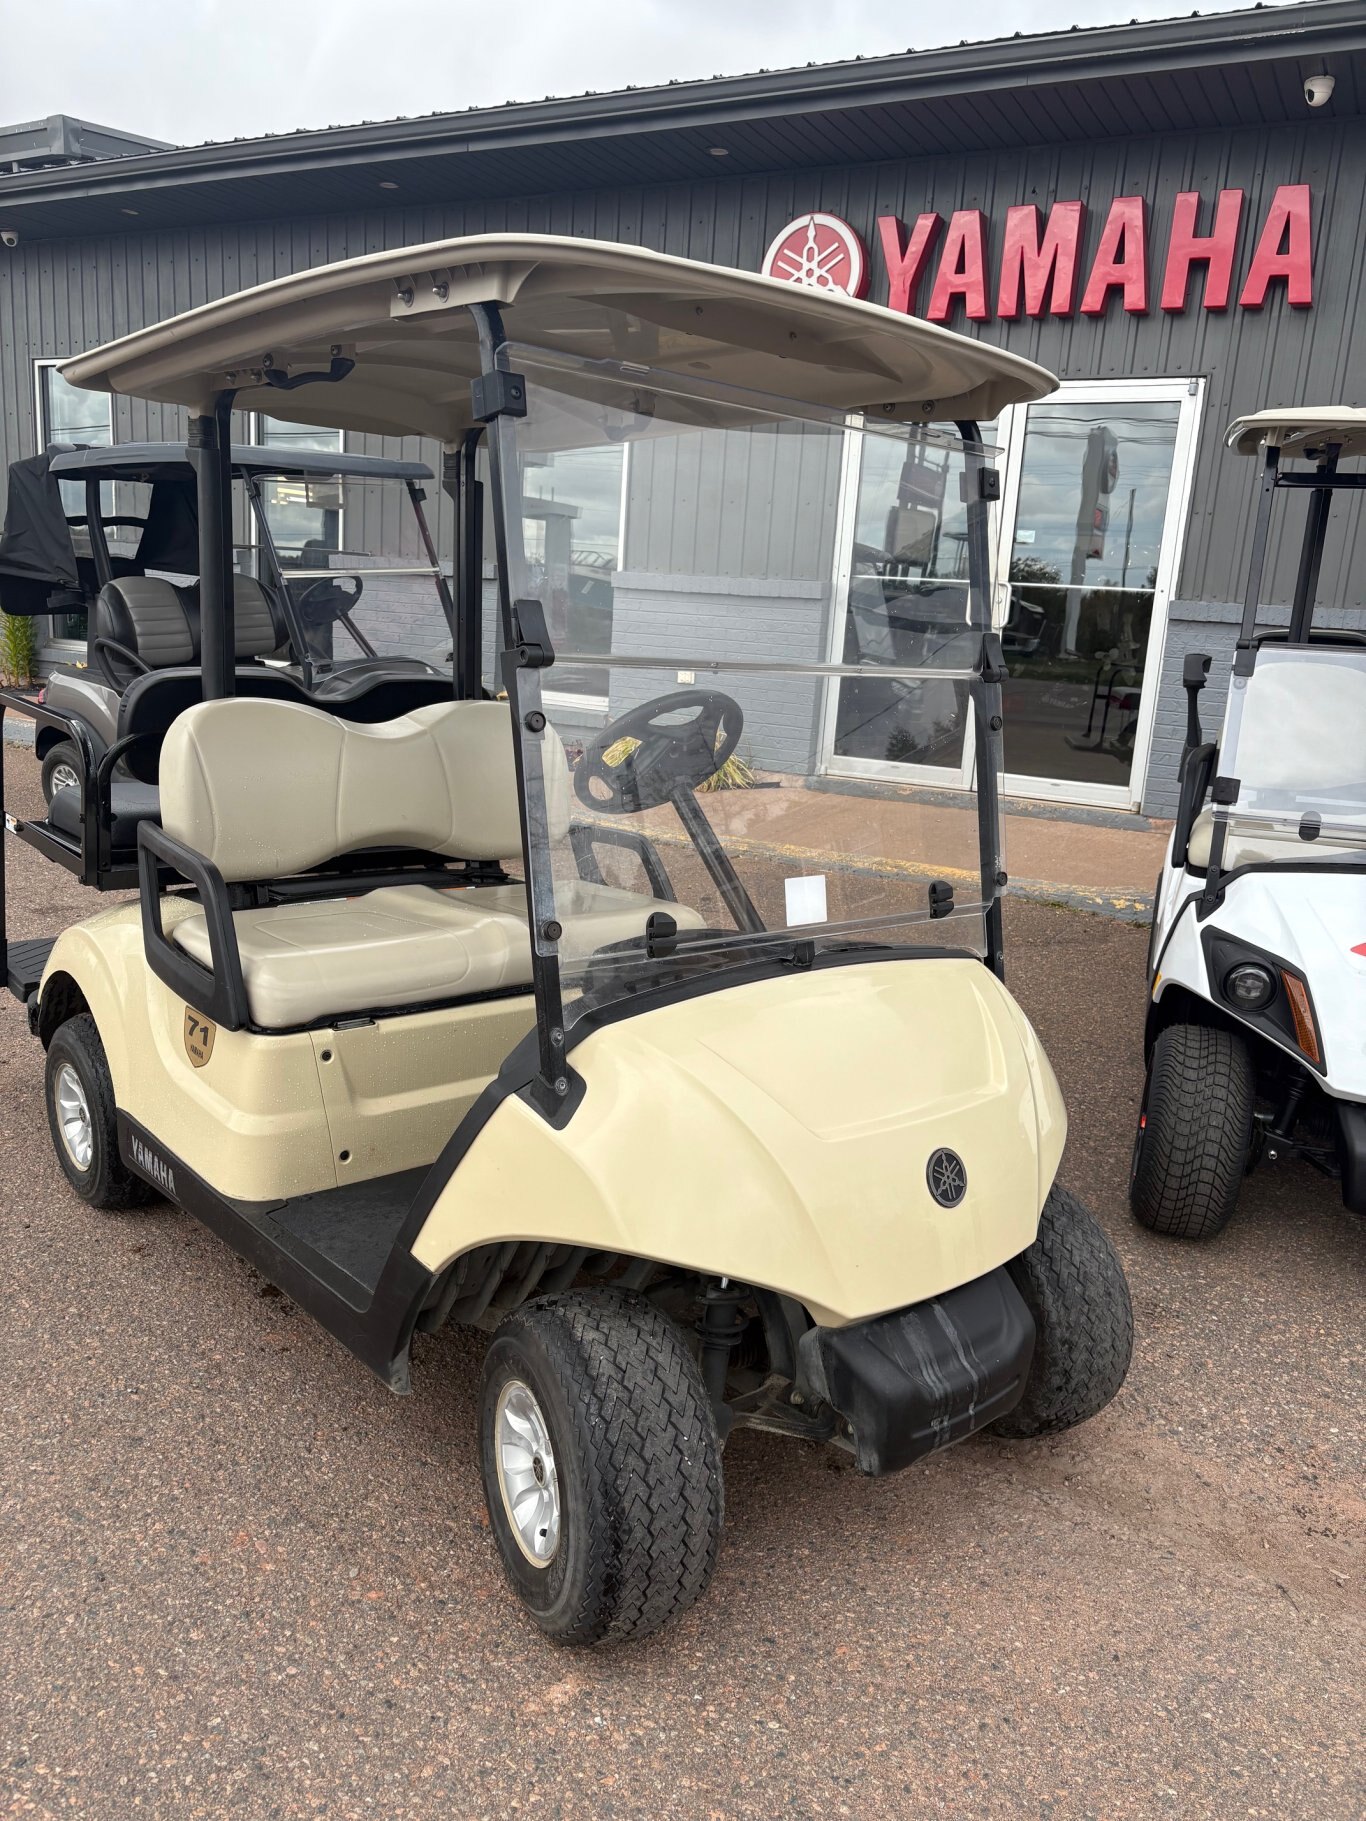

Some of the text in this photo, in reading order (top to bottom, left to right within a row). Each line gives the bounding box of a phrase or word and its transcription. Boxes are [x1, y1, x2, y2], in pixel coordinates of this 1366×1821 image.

[878, 185, 1312, 322] YAMAHA
[188, 1014, 209, 1047] 71
[131, 1134, 176, 1195] YAMAHA
